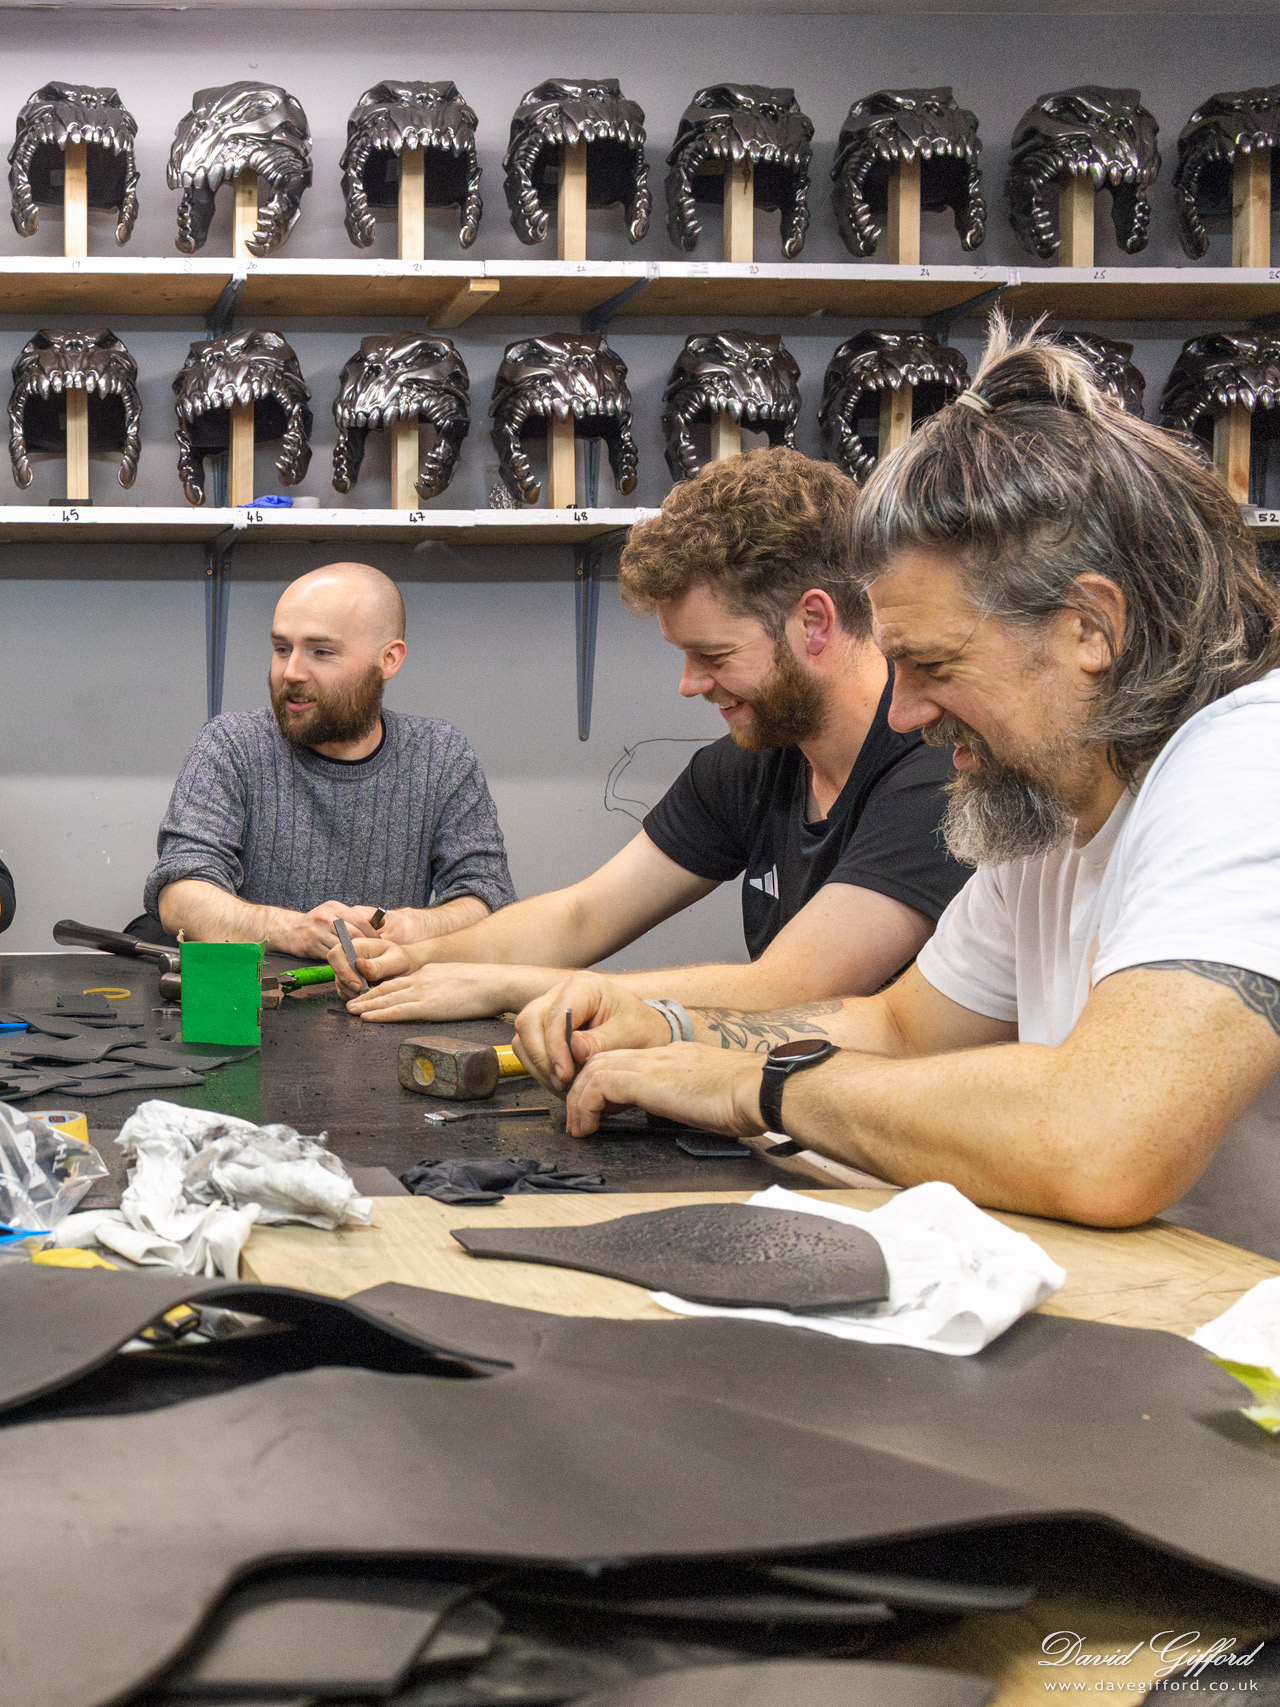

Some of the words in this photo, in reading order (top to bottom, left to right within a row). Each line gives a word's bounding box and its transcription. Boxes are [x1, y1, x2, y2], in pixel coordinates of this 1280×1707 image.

[246, 261, 258, 270] 20
[413, 263, 422, 272] 21
[920, 268, 930, 277] 24
[1094, 270, 1106, 279] 25
[62, 509, 79, 522] 45
[247, 511, 263, 523] 46
[409, 511, 426, 523] 47
[574, 511, 588, 523] 48
[1258, 513, 1279, 523] 52
